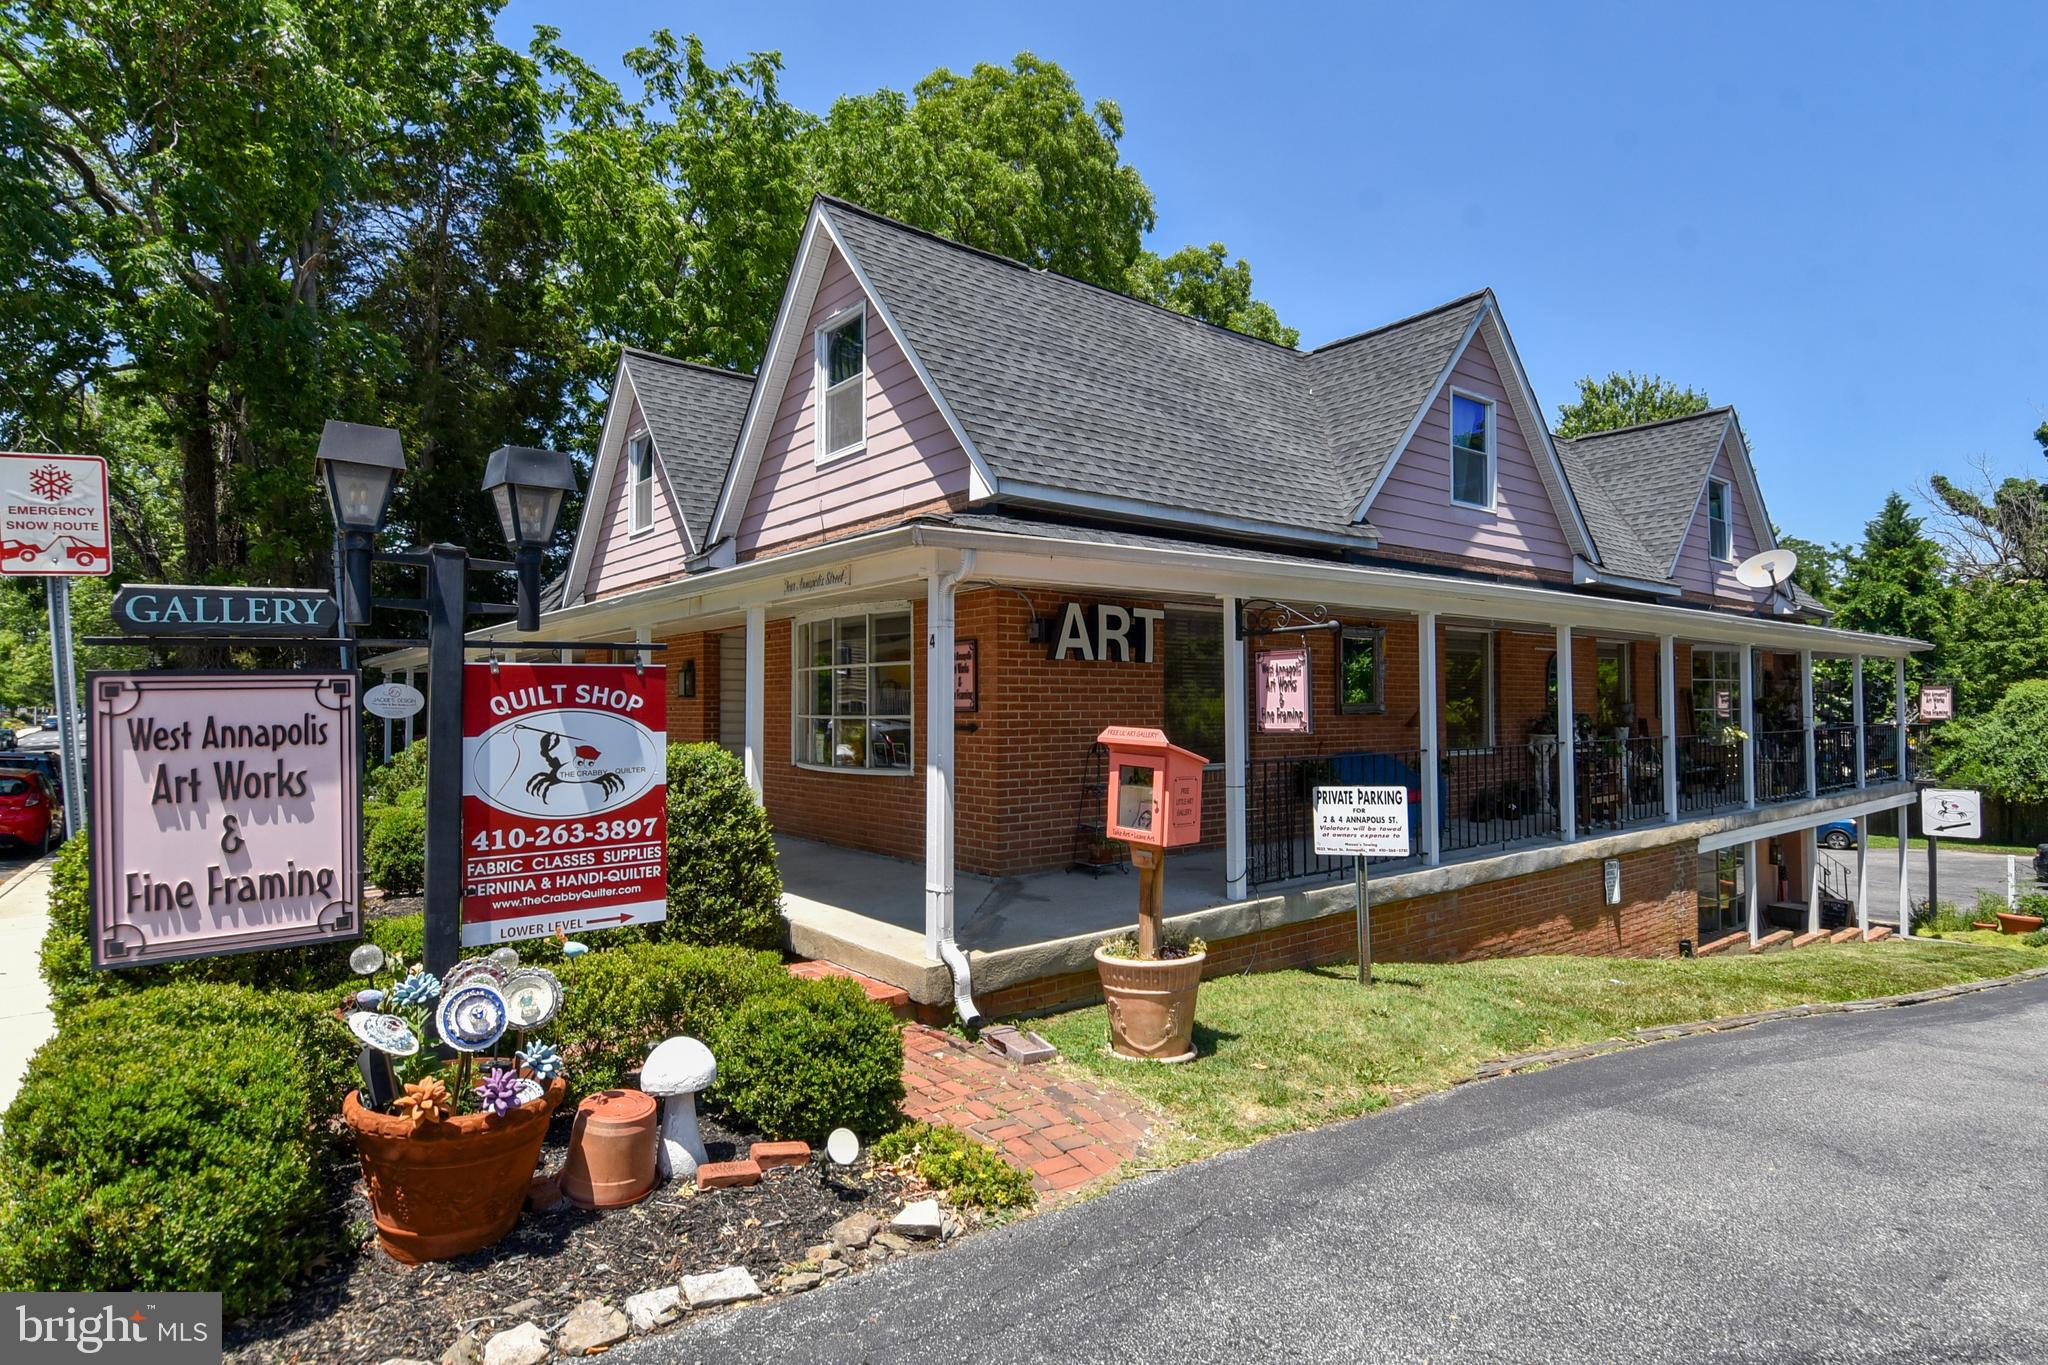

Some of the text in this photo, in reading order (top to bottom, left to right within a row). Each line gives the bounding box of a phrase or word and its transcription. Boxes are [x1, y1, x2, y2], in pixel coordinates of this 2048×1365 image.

[8, 506, 95, 516] EMERGENCY
[6, 521, 99, 531] SNOW ROUTE
[125, 595, 326, 625] GALLERY
[929, 634, 935, 648] 4
[1055, 602, 1164, 663] ART
[1266, 676, 1297, 692] Art Works
[490, 684, 644, 716] QUILT SHOP
[1262, 707, 1303, 722] Fine Framing
[127, 713, 328, 751] West Annapolis
[151, 759, 307, 804] Art Works
[576, 768, 608, 777] CRABBY
[615, 766, 646, 775] QUILTER
[1316, 790, 1402, 805] PRIVATE PARKING
[221, 814, 245, 853] &
[471, 817, 658, 851] 410-263-3897
[467, 846, 662, 877] FABRIC CLASSES SUPPLIES
[126, 860, 335, 913] Fine Framing
[541, 877, 551, 889] &
[556, 865, 661, 887] HANDI-QUILTER
[492, 885, 641, 910] www.TheCrabbyQuilter.com
[500, 918, 583, 939] LOWER LEVEL
